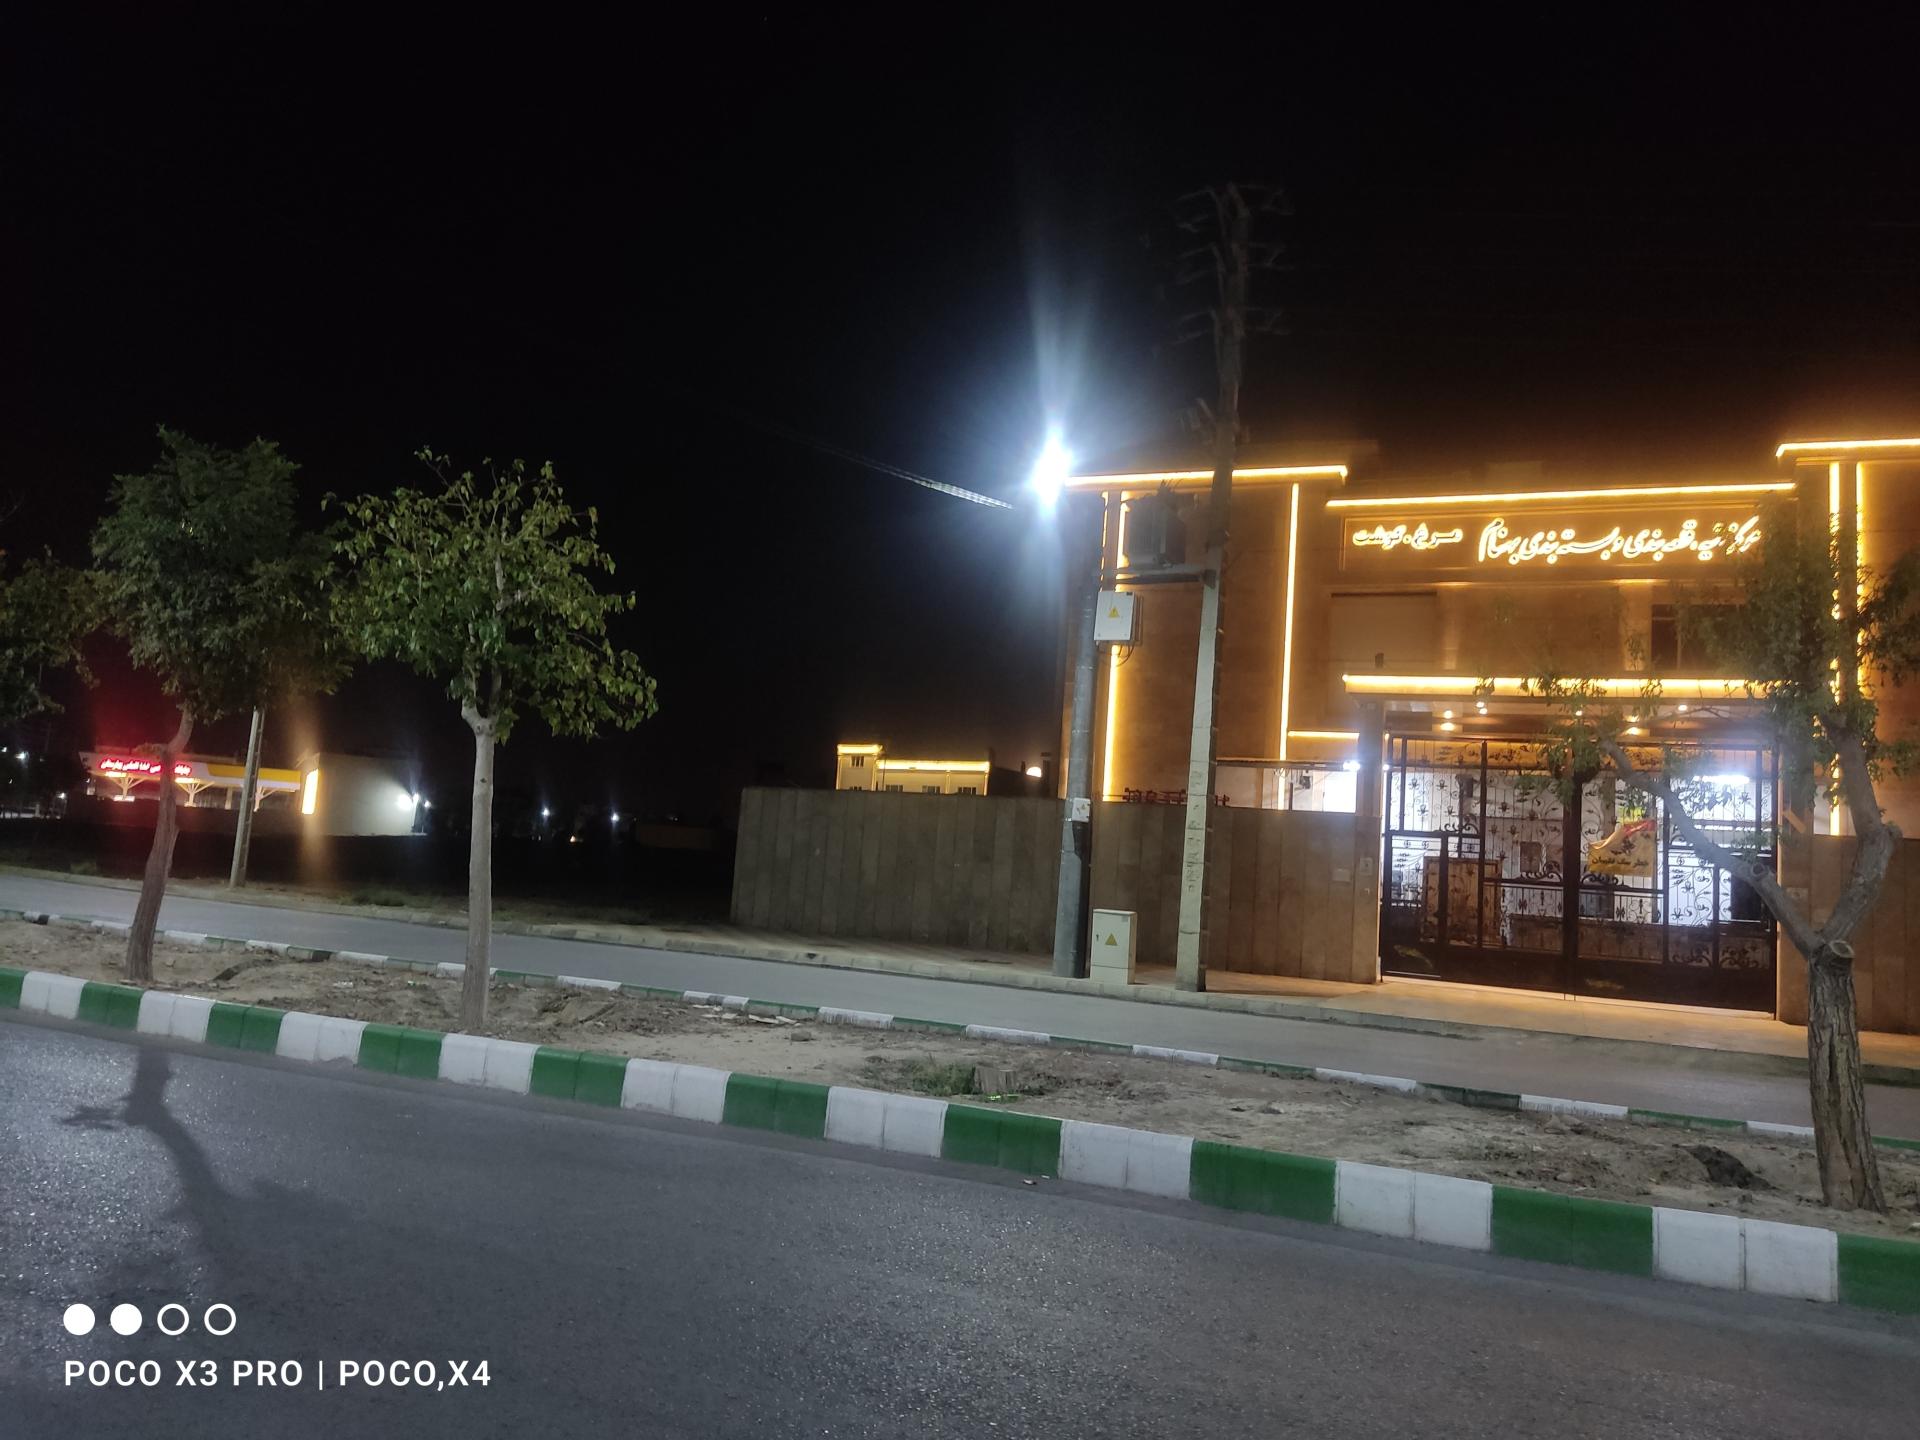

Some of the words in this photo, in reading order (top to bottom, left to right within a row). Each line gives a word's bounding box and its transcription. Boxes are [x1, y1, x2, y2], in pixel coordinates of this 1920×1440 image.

[1478, 517, 1522, 565] بهنام
[1519, 530, 1560, 564] بندی
[1555, 527, 1621, 560] بسته
[1622, 528, 1666, 561] بندی
[1661, 519, 1698, 552] قطعه
